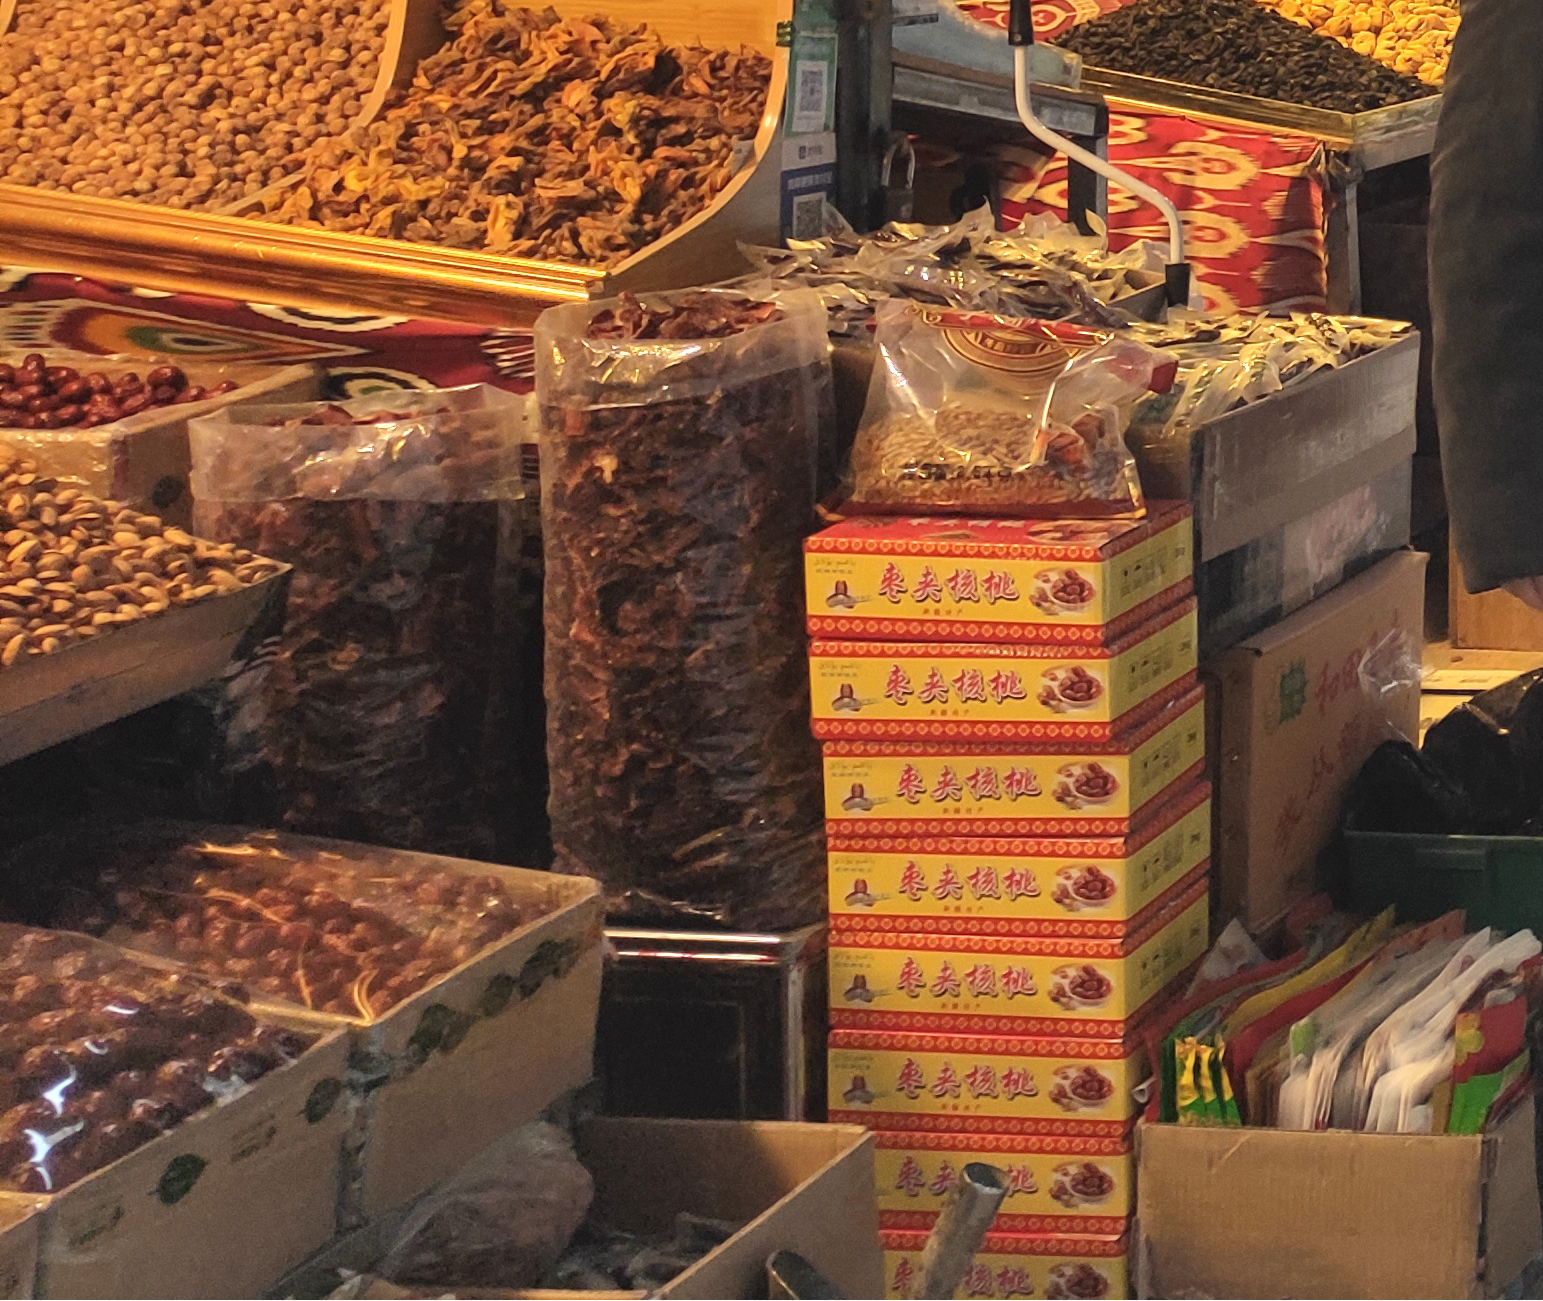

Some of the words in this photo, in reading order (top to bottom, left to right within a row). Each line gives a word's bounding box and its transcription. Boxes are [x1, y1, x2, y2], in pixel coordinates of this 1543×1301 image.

[878, 561, 1020, 605] 枣夹核桃
[885, 664, 1028, 706] 枣夹核桃
[896, 763, 1042, 804] 枣夹核桃
[899, 860, 1041, 902] 枣夹核桃
[897, 956, 1037, 999] 枣夹核桃
[896, 1058, 1038, 1100] 枣夹核桃
[896, 1156, 1038, 1196] 枣夹桃
[892, 1257, 1035, 1298] 枣核桃
